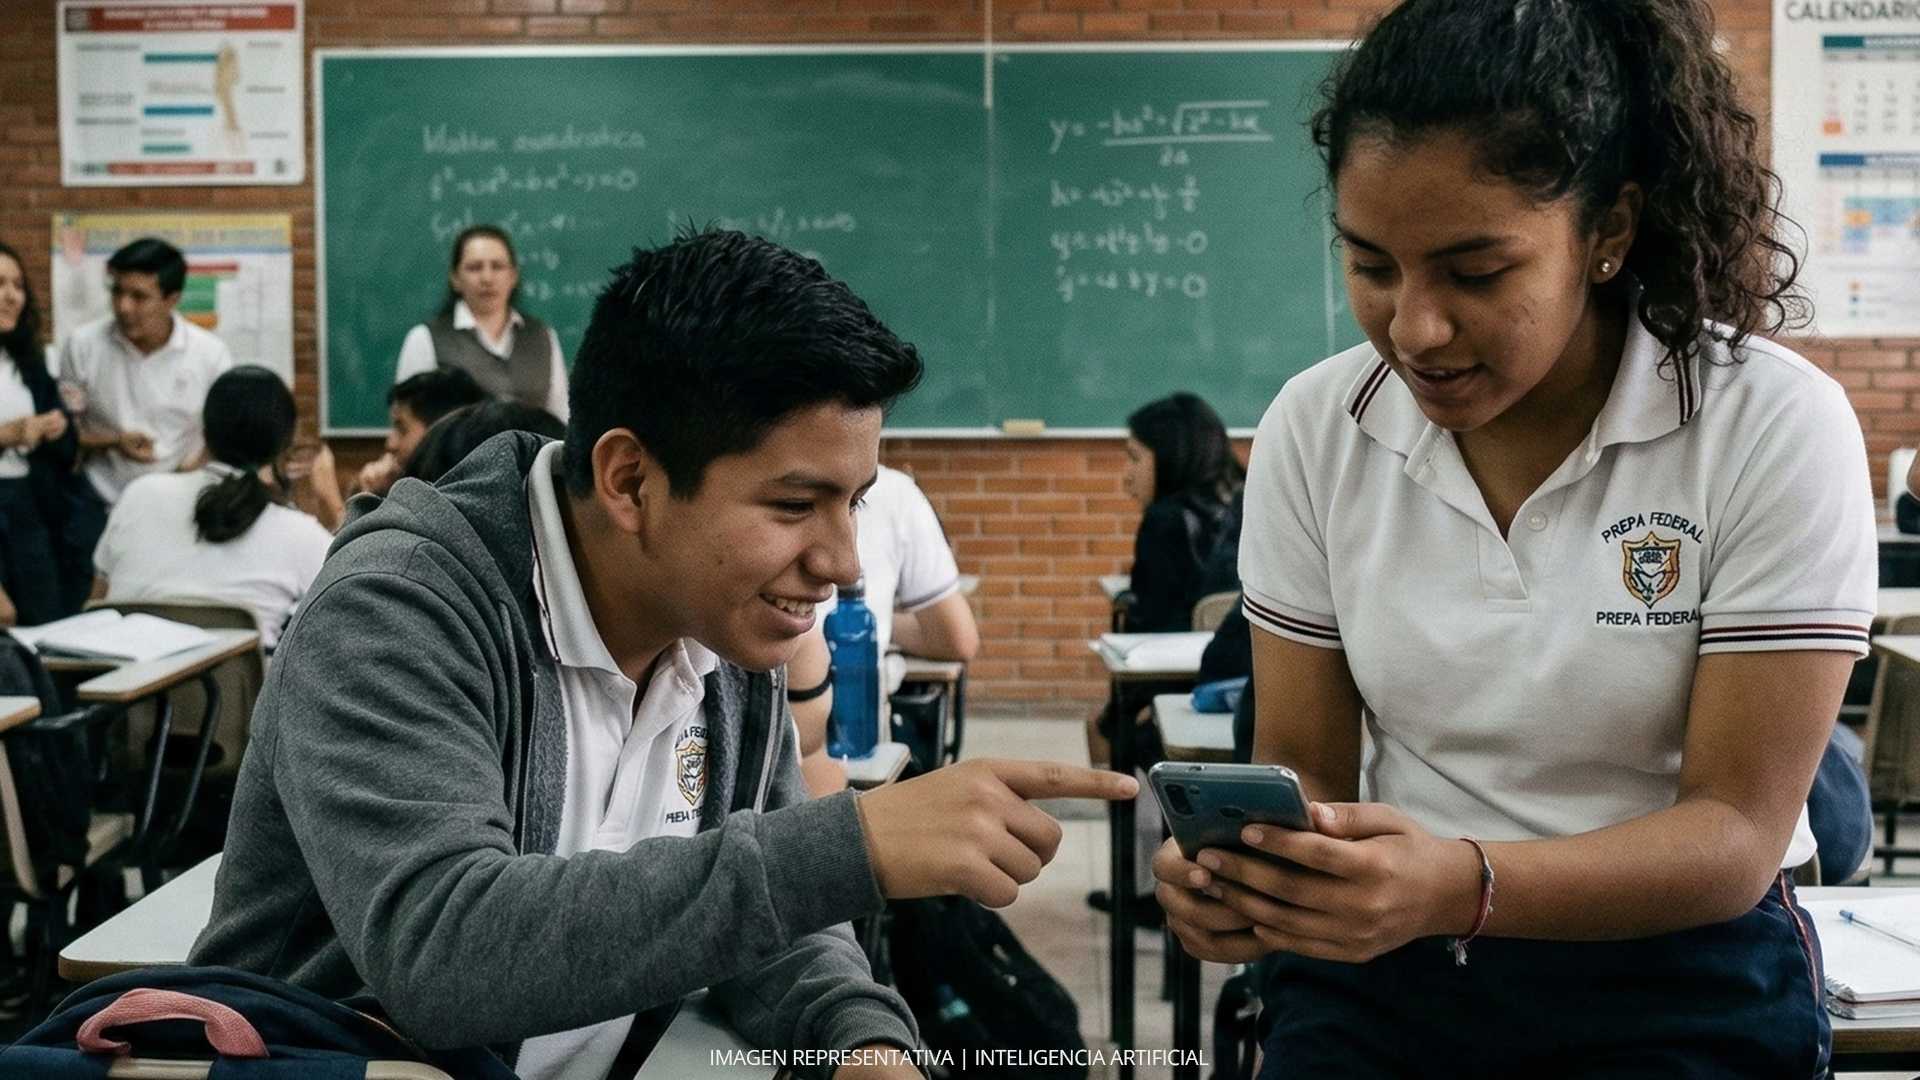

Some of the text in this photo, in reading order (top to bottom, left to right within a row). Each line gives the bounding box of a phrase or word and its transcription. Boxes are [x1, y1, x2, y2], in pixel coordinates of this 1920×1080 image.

[1601, 511, 1704, 544] PREPA FEDERAL
[1596, 608, 1699, 625] PREPA FEDERA
